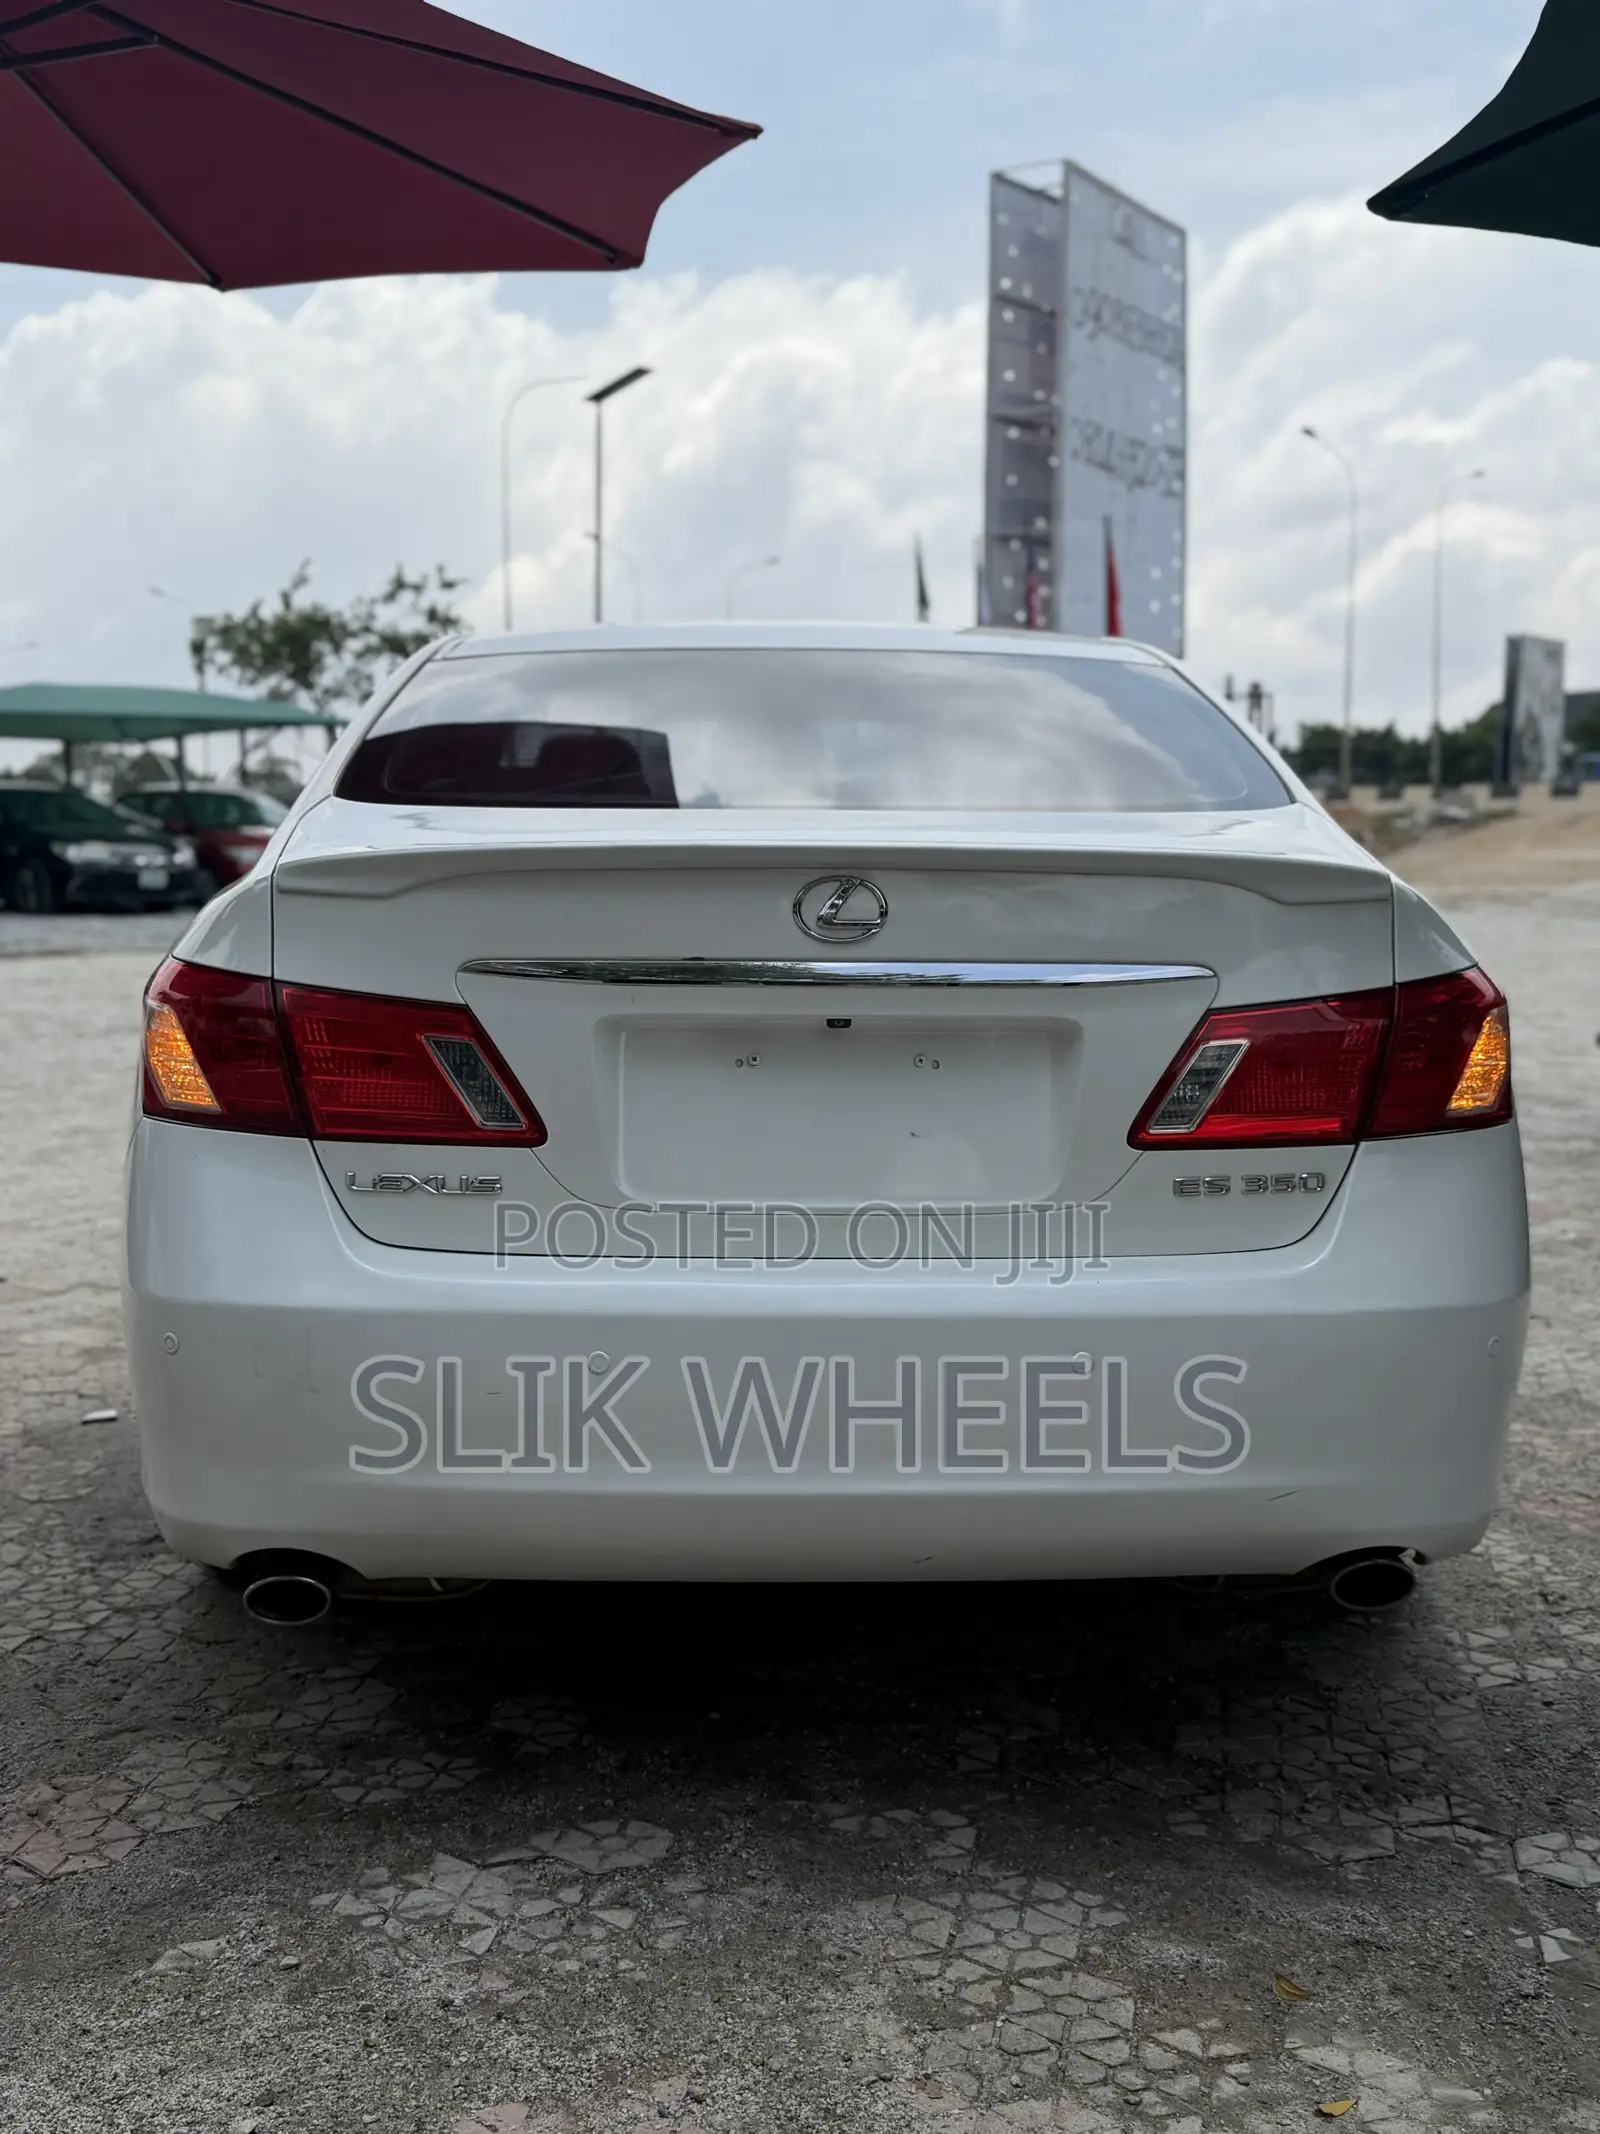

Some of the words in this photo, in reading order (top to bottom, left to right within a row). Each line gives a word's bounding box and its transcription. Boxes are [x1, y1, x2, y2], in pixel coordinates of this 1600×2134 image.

[345, 1171, 502, 1195] LEXUS
[1172, 1175, 1231, 1198] ES
[1240, 1172, 1327, 1195] 350
